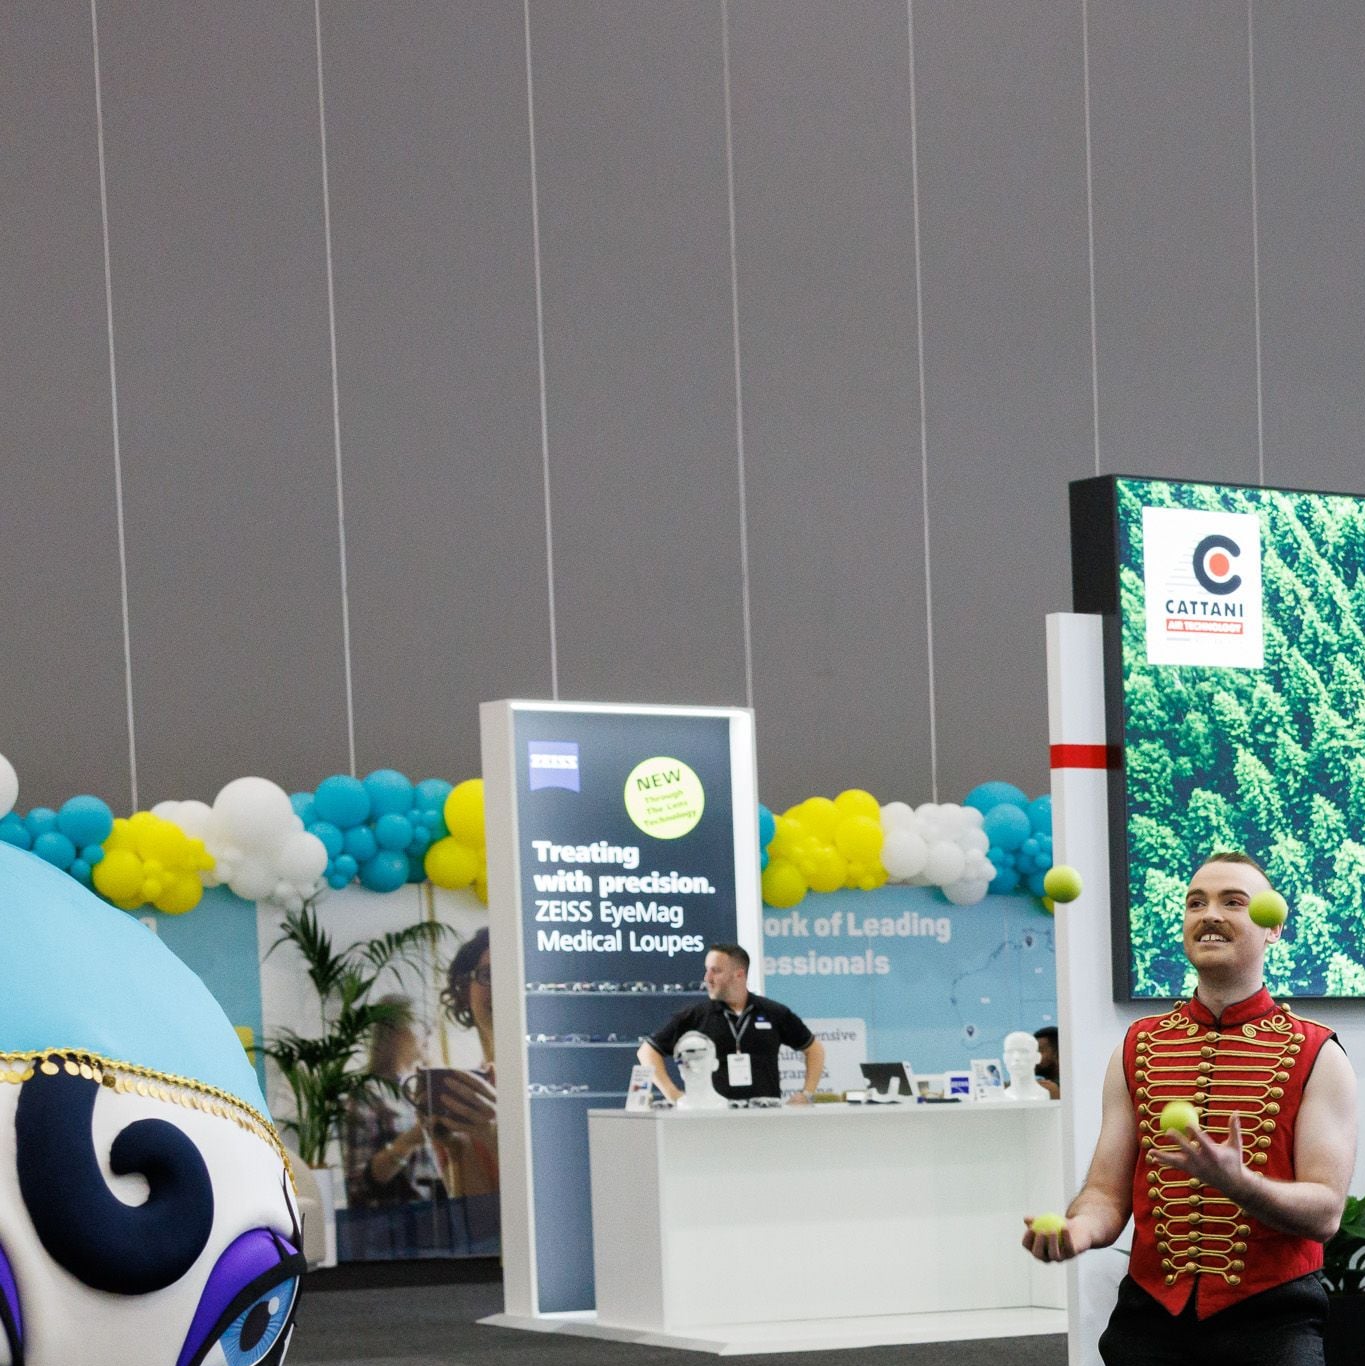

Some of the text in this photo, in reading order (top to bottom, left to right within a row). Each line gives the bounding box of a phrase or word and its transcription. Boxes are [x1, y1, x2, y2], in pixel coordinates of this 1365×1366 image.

[1165, 599, 1244, 617] CATTANI
[636, 768, 681, 791] NEW
[532, 840, 640, 869] Treating
[533, 869, 717, 898] with precision.
[534, 900, 684, 929] ZEISS EyeMag
[763, 911, 952, 943] ork of Leading
[537, 929, 705, 957] Medical Loupes
